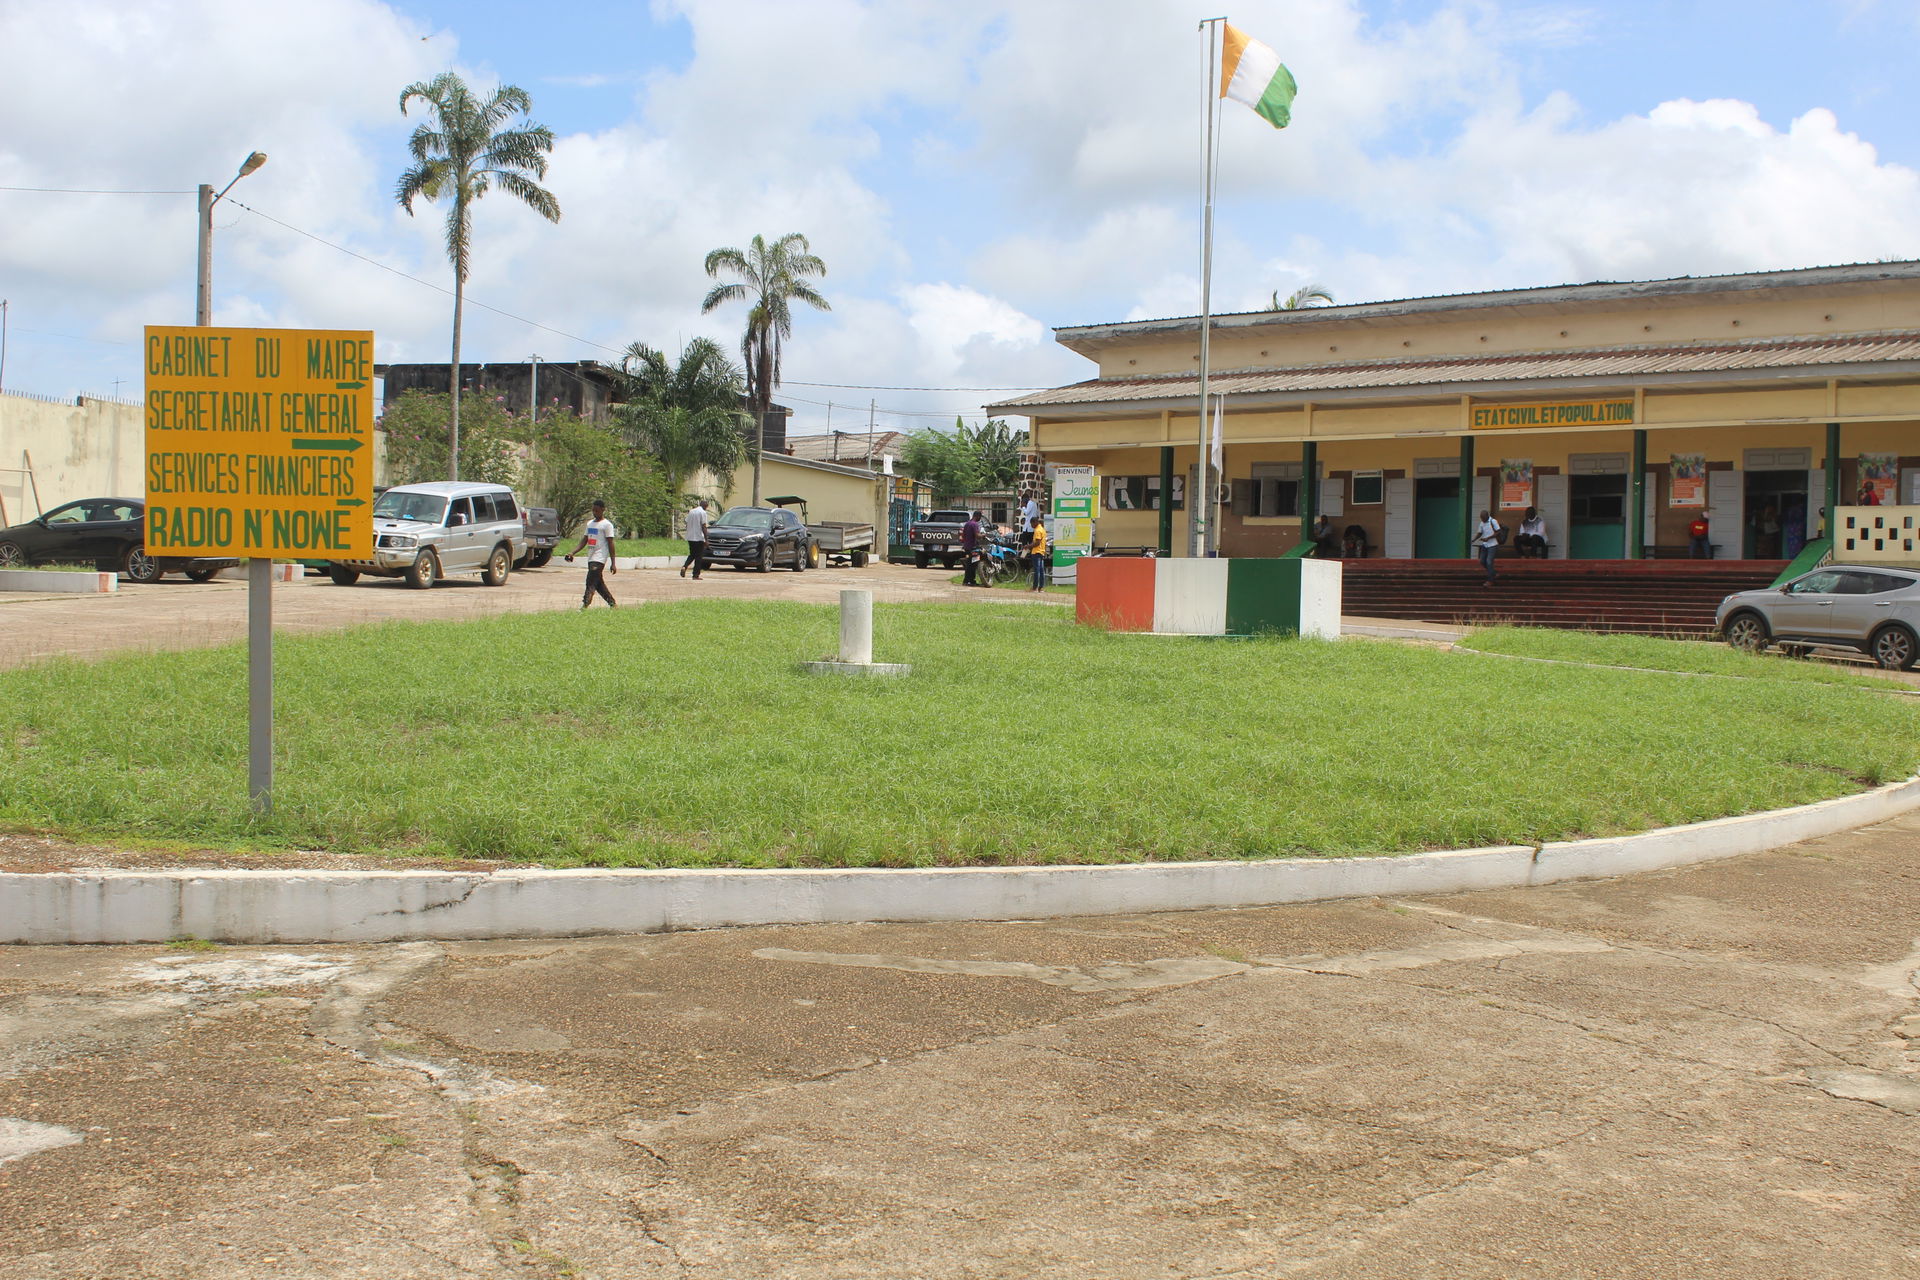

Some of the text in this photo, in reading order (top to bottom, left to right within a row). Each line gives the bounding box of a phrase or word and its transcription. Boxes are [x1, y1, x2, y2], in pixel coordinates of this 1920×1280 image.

[149, 335, 369, 380] CABINET DU MAIRE
[149, 390, 363, 433] SECRETARIAT GENERAL
[149, 452, 354, 496] SERVICES FINANCIERS
[1062, 479, 1099, 496] Jeunes
[149, 506, 351, 550] RADIO N'NOWE
